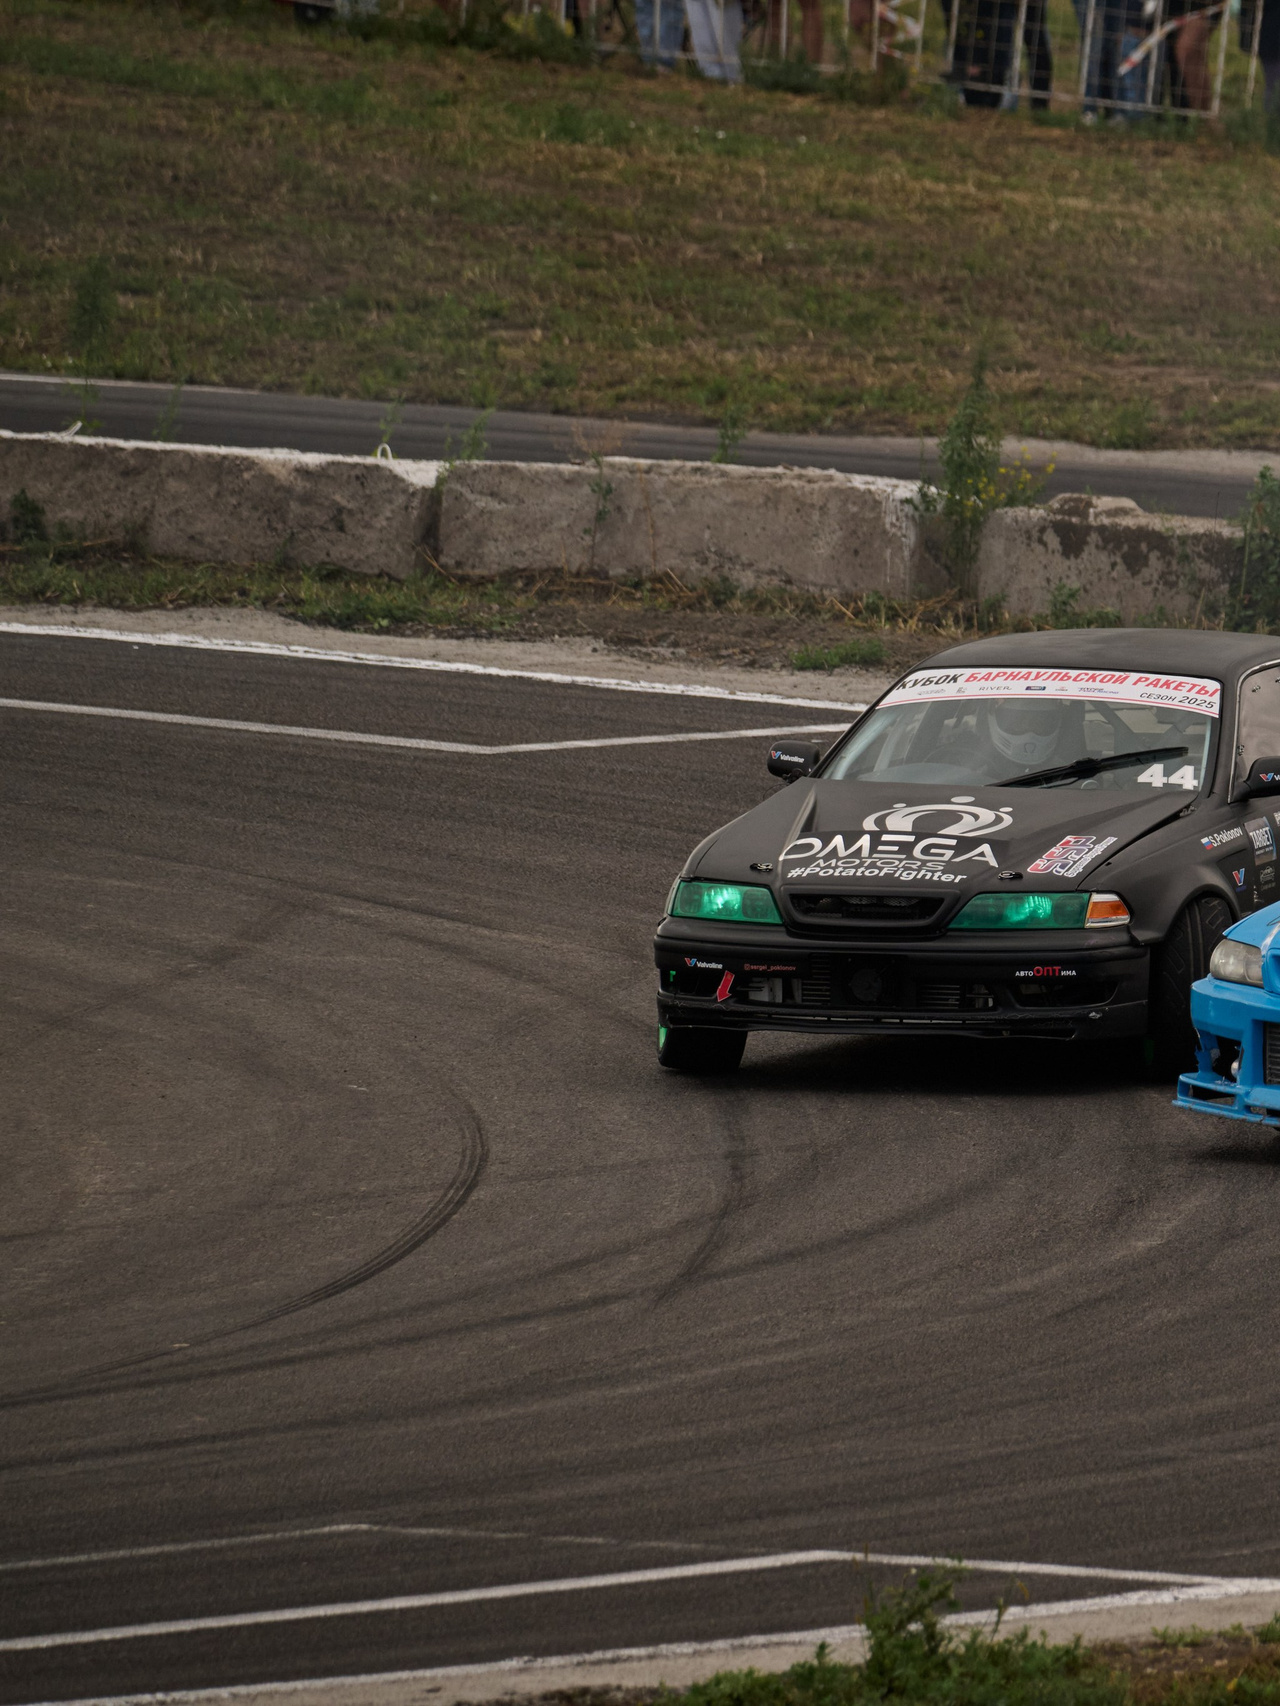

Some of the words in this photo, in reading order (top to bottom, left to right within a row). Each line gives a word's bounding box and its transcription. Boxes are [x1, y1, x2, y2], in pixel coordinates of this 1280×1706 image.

[896, 673, 965, 691] КУБОК
[964, 671, 1131, 685] БАРНАУЛЬСКОЙ
[1132, 676, 1221, 698] РАКЕТЫ
[1139, 692, 1178, 702] СЕЗОН
[1178, 695, 1217, 709] 2025
[780, 754, 805, 763] Valvoline
[1137, 763, 1198, 790] 44
[1208, 826, 1243, 847] S.Poklonov
[1249, 826, 1273, 849] TARGET
[779, 834, 998, 868] OMEGA
[810, 859, 947, 871] MOTORS
[787, 867, 967, 883] #PotatoFighter
[697, 961, 723, 970] Valvoline
